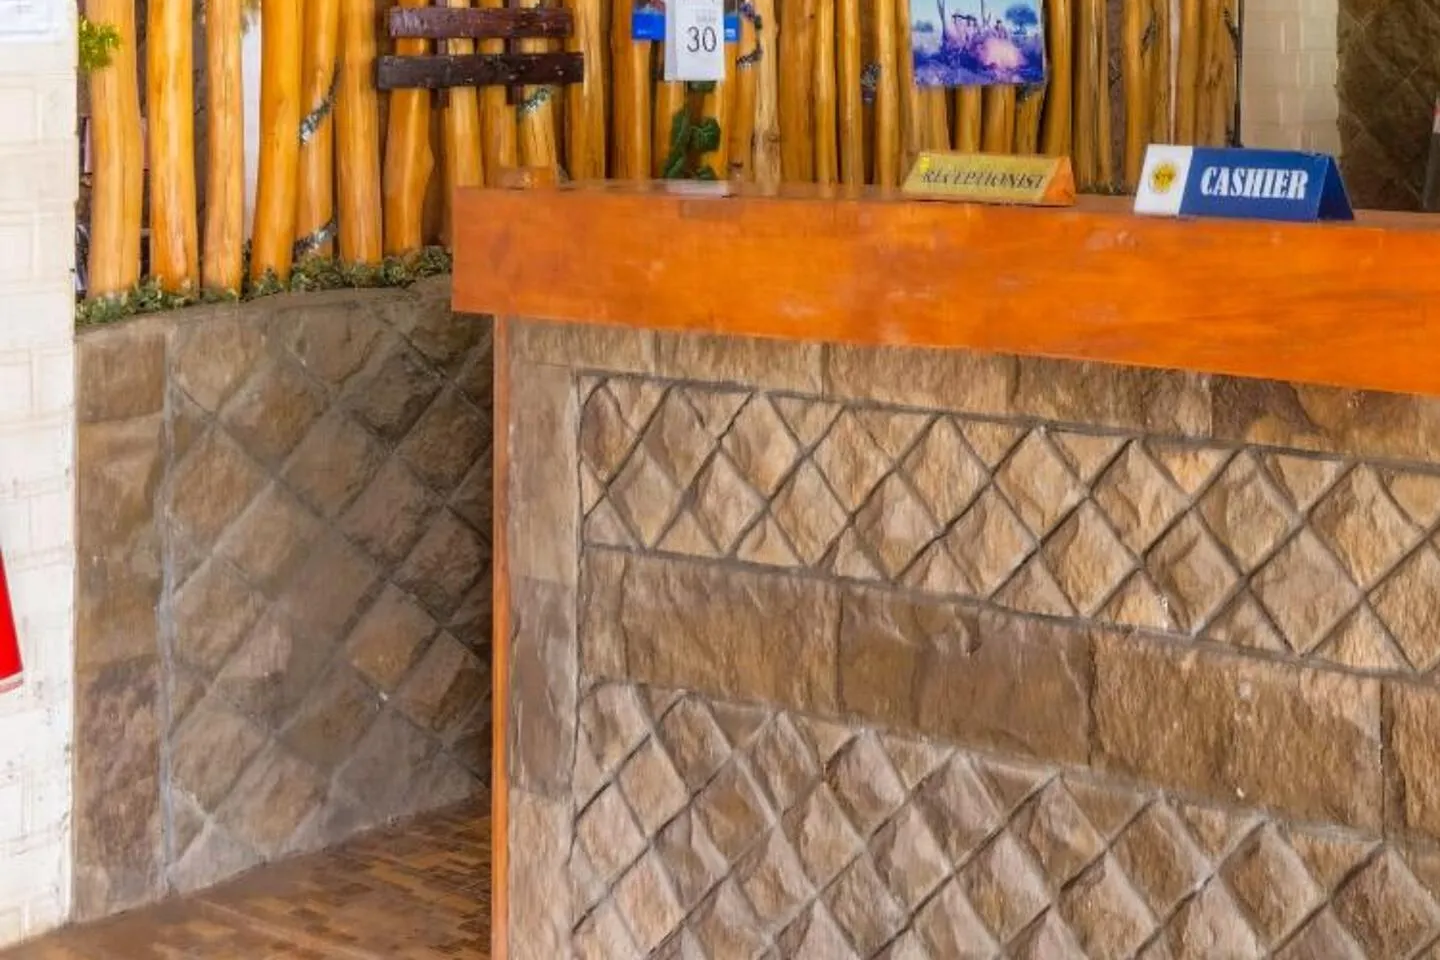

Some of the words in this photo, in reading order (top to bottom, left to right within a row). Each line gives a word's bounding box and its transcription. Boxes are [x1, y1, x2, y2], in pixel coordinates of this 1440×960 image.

[687, 26, 717, 53] 30
[921, 168, 1045, 189] RECEPTIONIST
[1200, 166, 1309, 200] CASHIER
